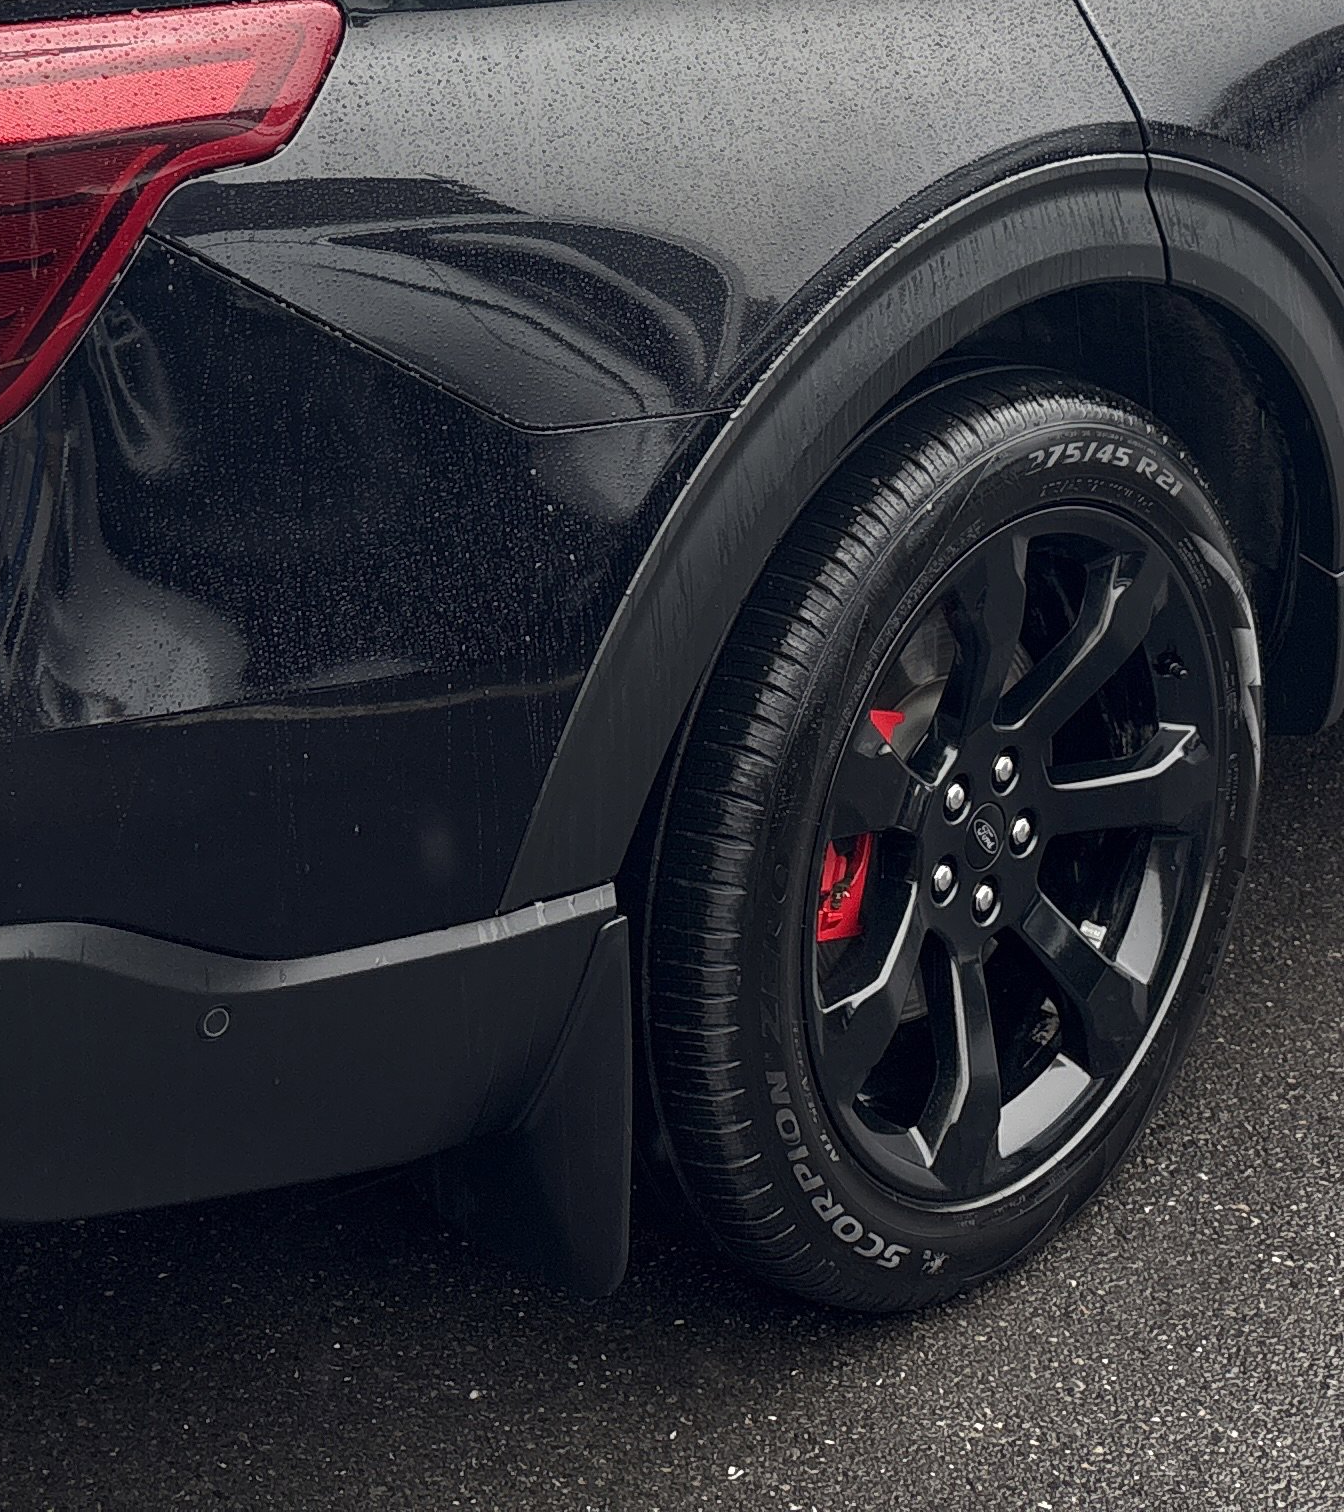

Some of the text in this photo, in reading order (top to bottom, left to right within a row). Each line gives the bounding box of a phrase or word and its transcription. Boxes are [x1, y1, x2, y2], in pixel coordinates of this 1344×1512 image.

[1025, 441, 1134, 476] 275/45
[977, 824, 996, 849] Ford
[765, 1070, 912, 1269] SCORPION
